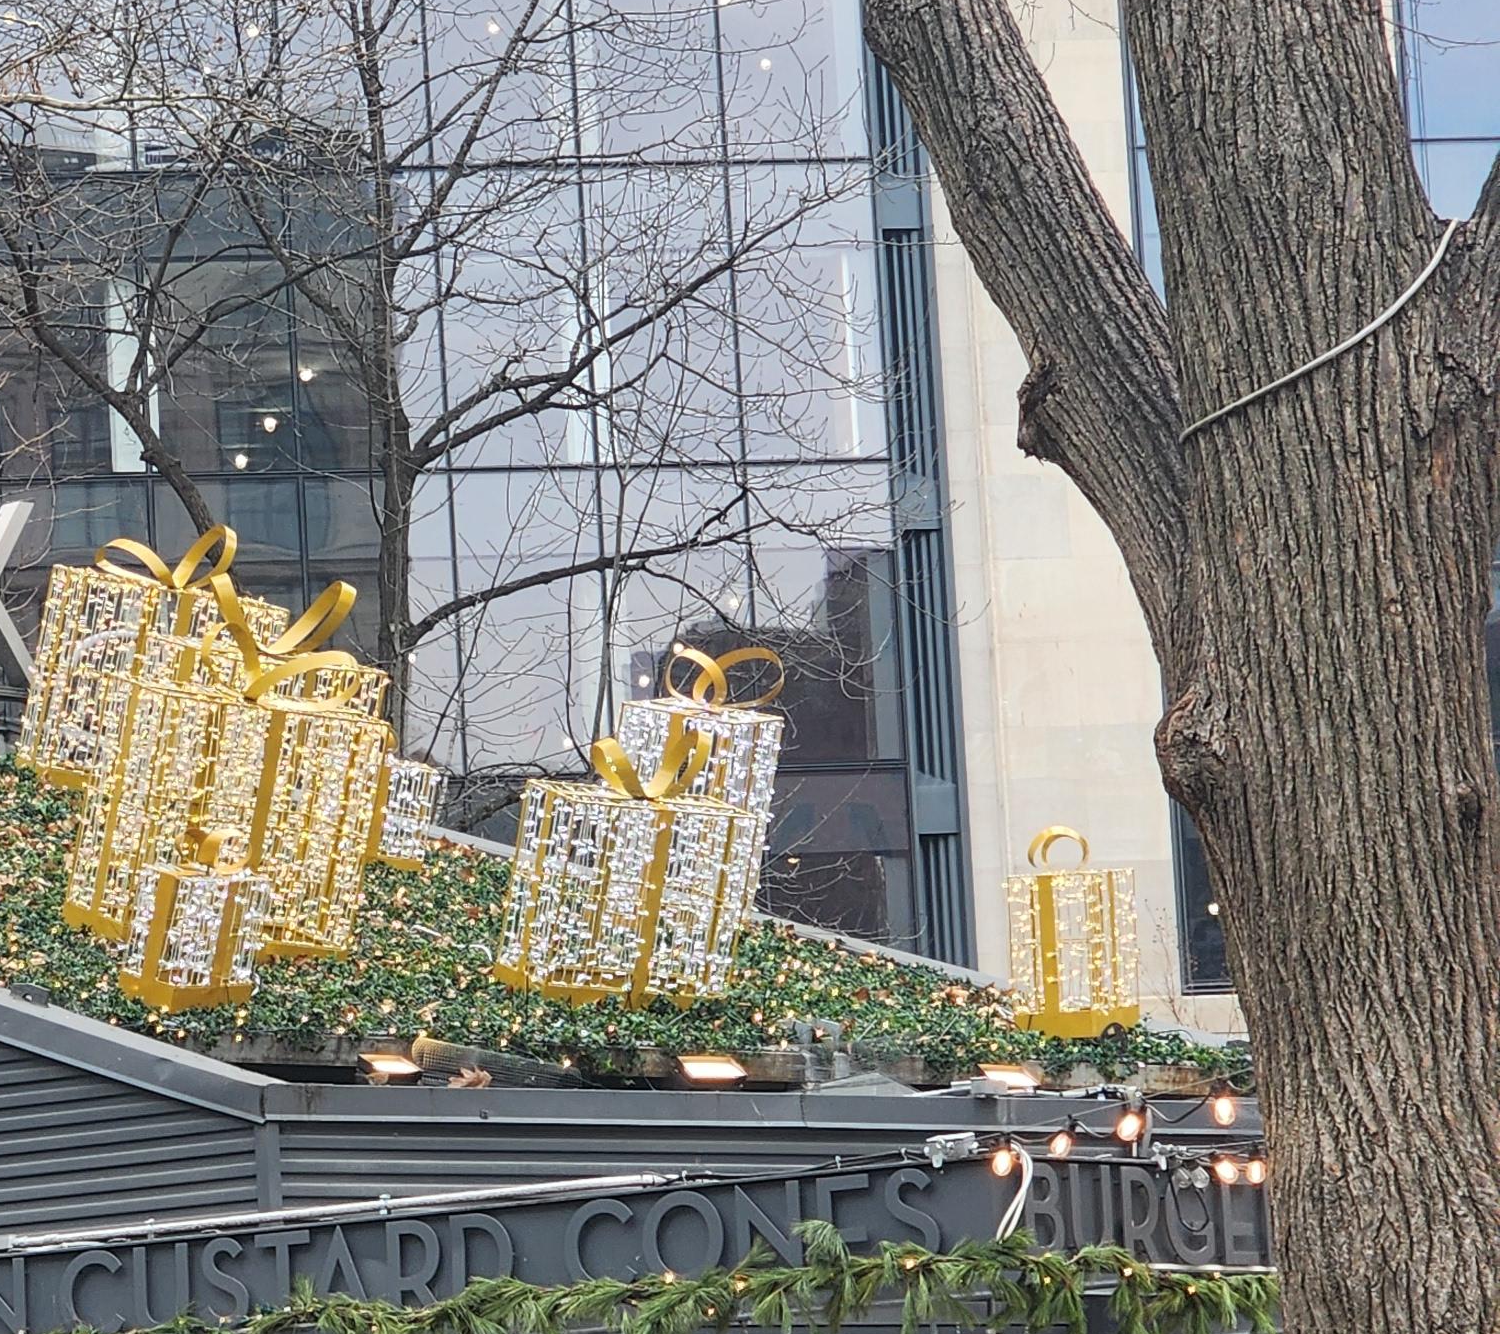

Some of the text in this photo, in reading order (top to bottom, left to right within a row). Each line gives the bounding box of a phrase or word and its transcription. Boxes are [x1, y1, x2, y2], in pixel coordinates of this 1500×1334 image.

[60, 1214, 514, 1329] CUSTARD
[564, 1169, 942, 1283] CONES
[1023, 1161, 1272, 1265] BURGE
